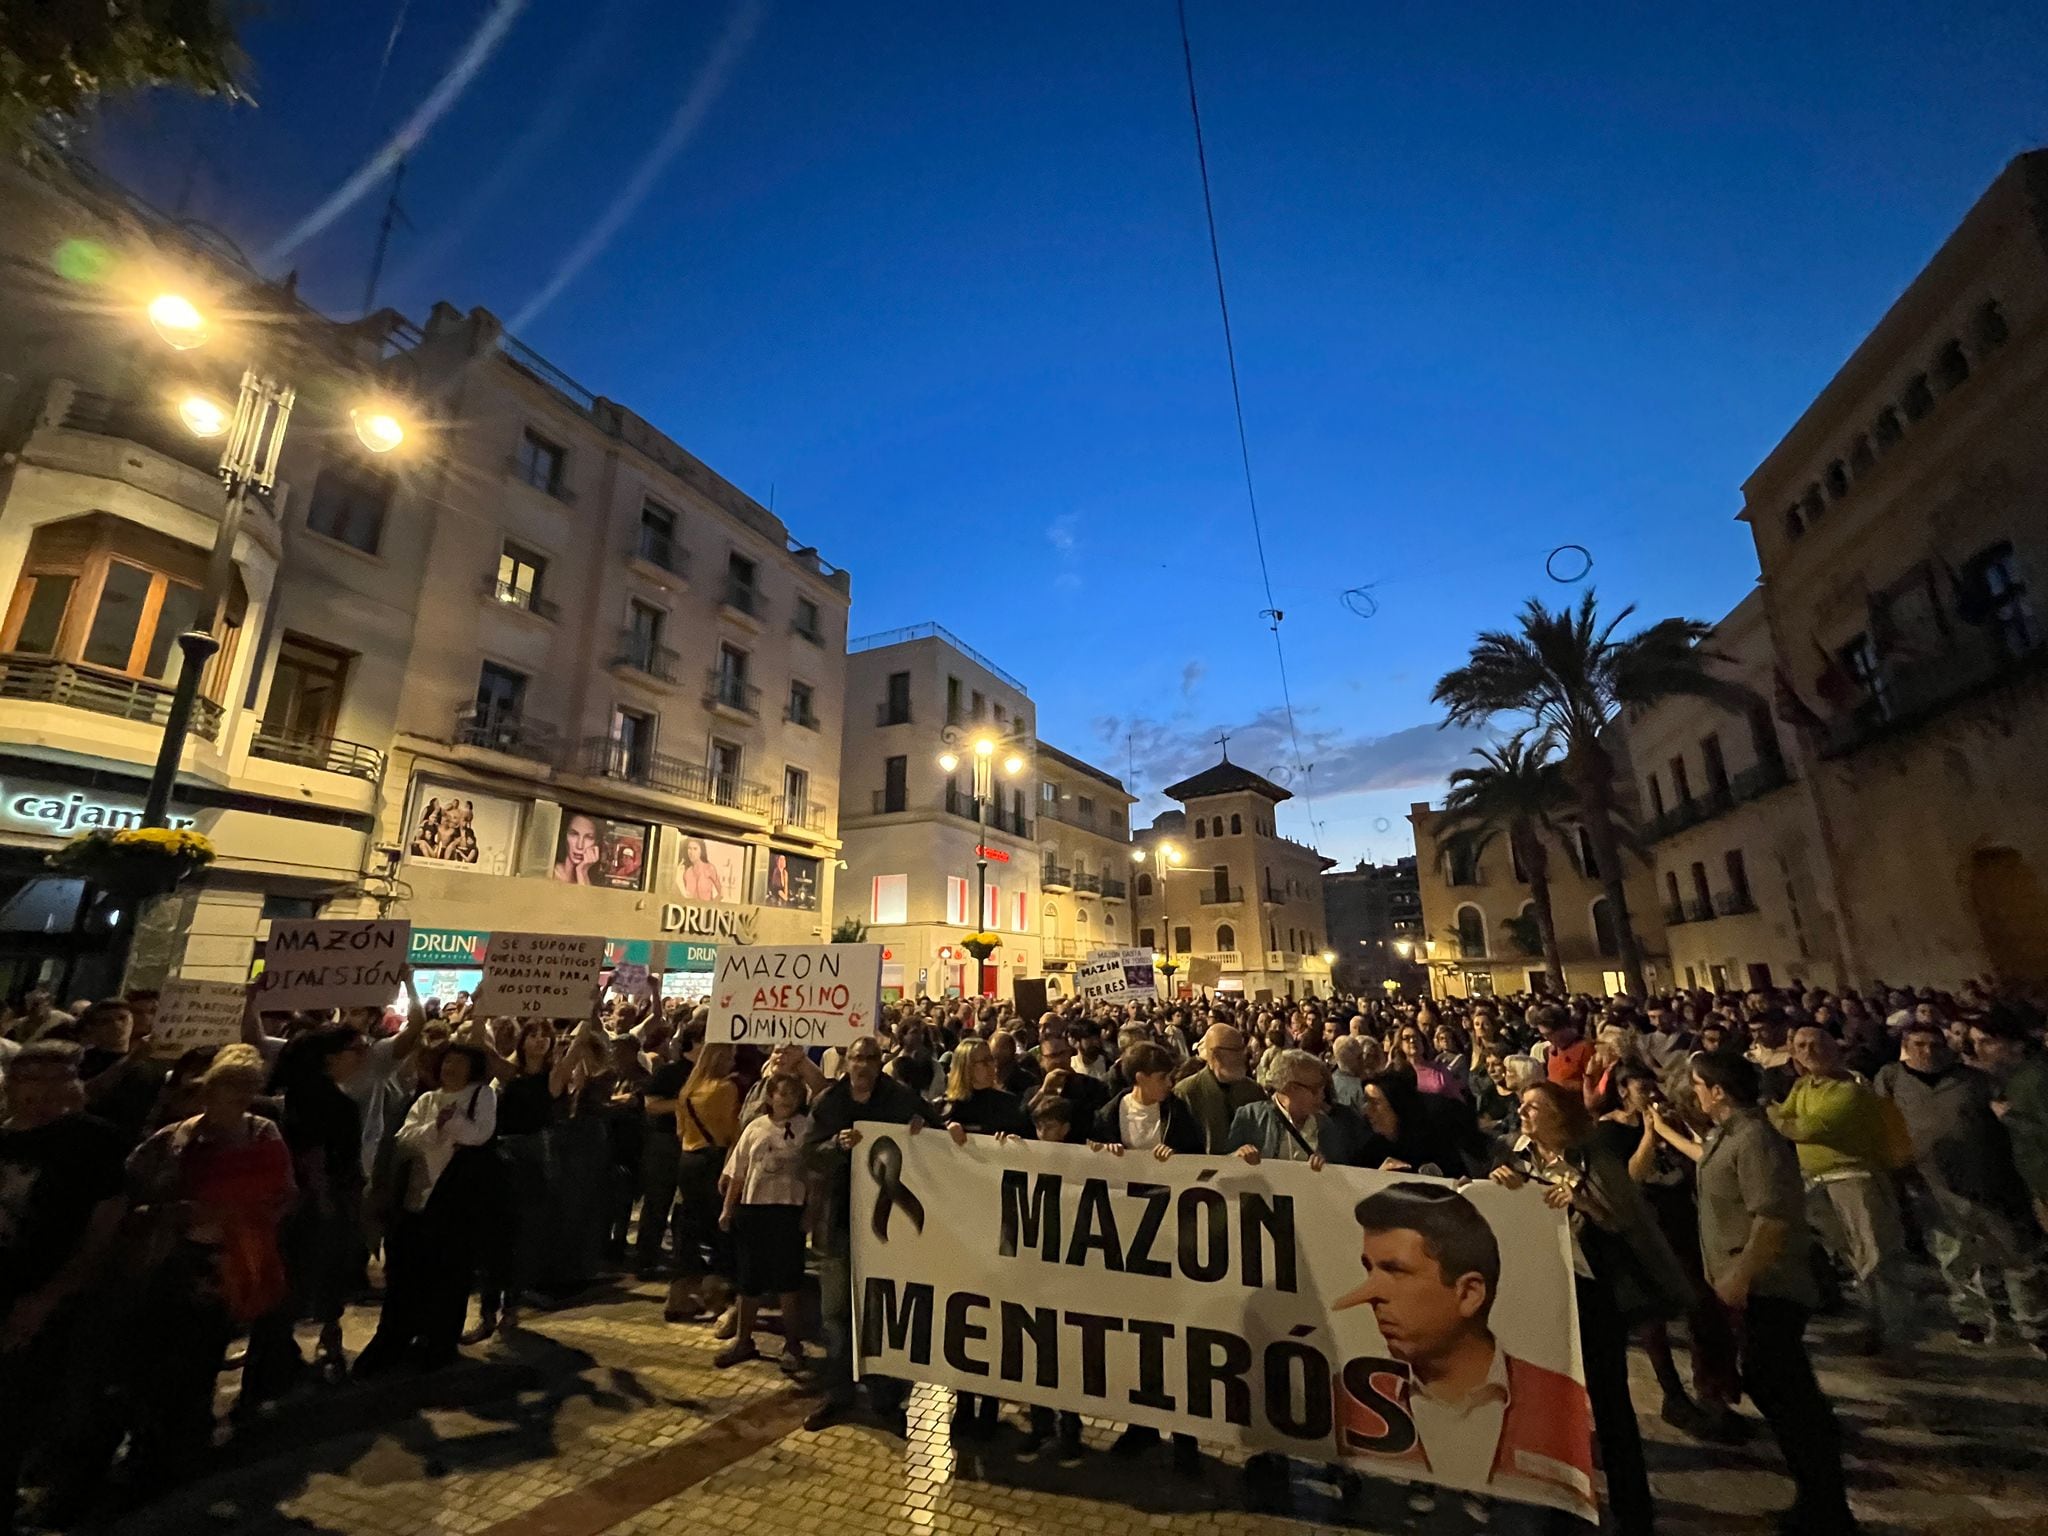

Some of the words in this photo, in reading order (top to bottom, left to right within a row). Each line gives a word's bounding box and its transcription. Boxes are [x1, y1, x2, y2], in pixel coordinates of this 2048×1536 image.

[13, 794, 195, 831] cajamr
[664, 903, 737, 936] DRUNI
[276, 924, 394, 950] MAZÓN
[412, 933, 478, 953] DRUNI
[501, 939, 519, 950] SE
[530, 940, 587, 953] SUPONE
[687, 947, 717, 960] DRUN
[262, 960, 401, 991] DIMISIÓN
[489, 966, 550, 978] TRABAJAN
[560, 970, 590, 982] PARA
[721, 953, 840, 982] MAZON
[498, 984, 569, 996] NOSOTROS
[752, 984, 849, 1010] ASESINO
[522, 1000, 541, 1011] XD
[731, 1014, 826, 1041] DIMISION
[999, 1169, 1297, 1293] MAZÓN
[861, 1276, 1419, 1454] MENTIRÓS
